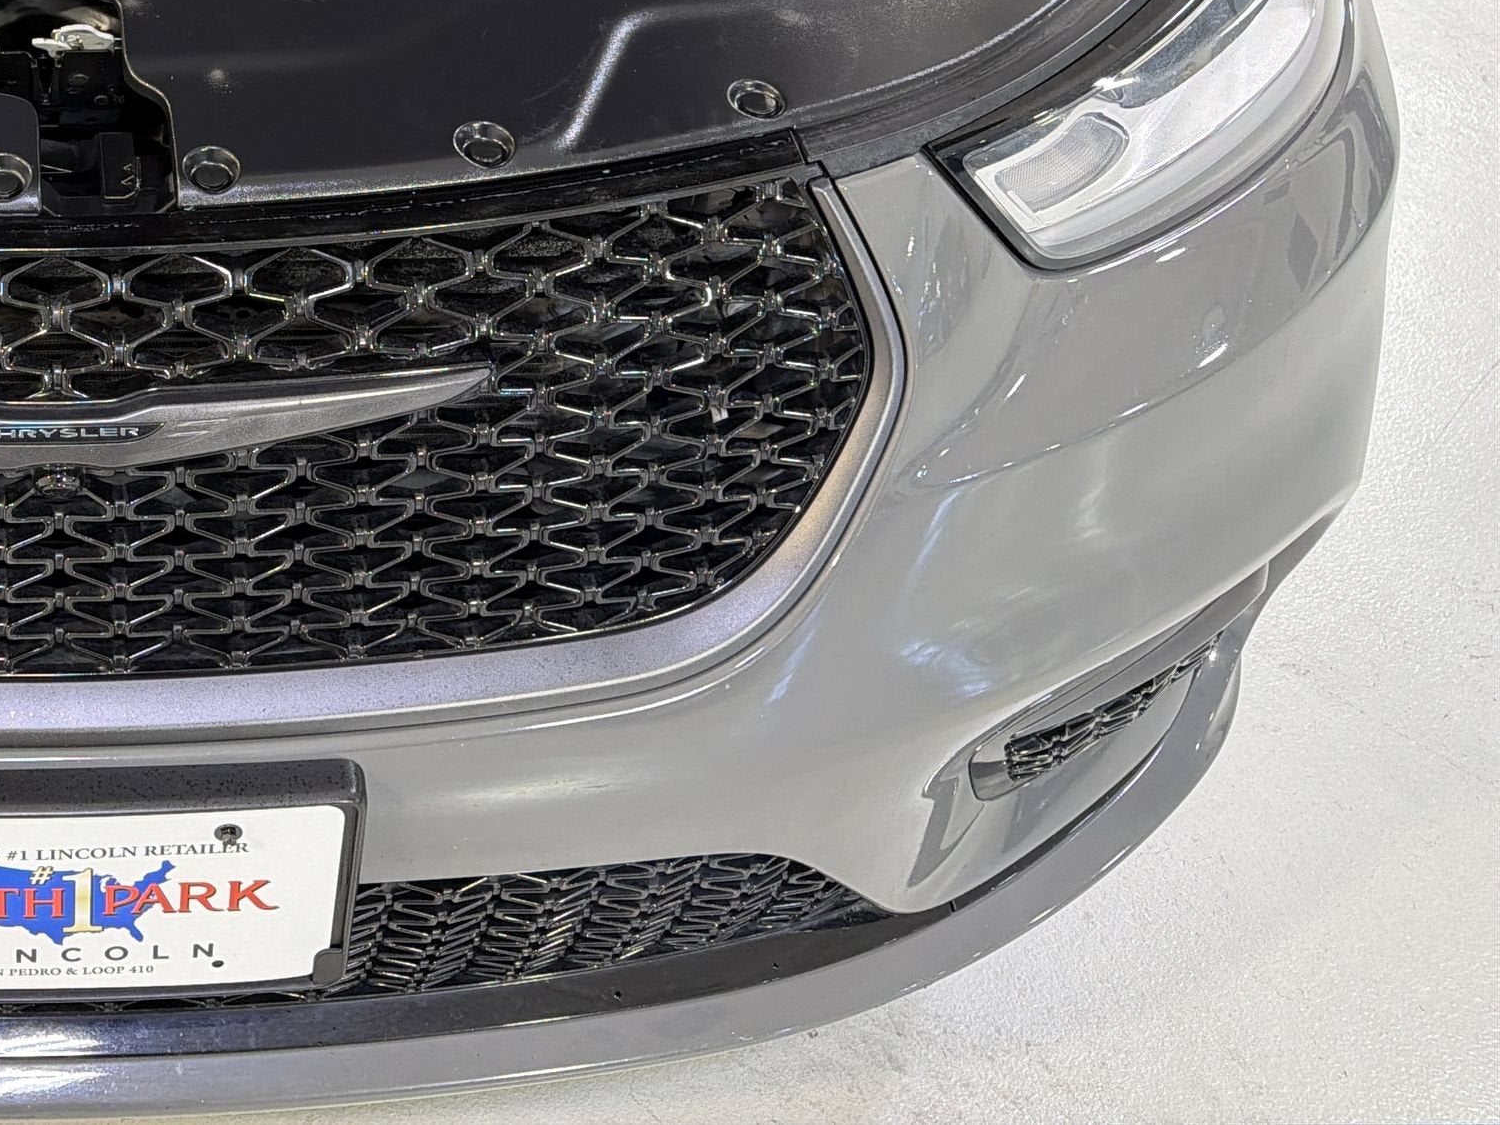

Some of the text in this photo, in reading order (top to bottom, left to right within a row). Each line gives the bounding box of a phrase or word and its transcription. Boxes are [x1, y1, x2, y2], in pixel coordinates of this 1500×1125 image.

[6, 849, 27, 861] #1
[35, 846, 137, 861] LINCOLN
[144, 842, 250, 857] RETAILER
[102, 879, 281, 917] PARK
[9, 966, 62, 977] PEDRO
[65, 966, 78, 976] &
[82, 965, 126, 976] LOOP
[128, 964, 155, 974] 410
